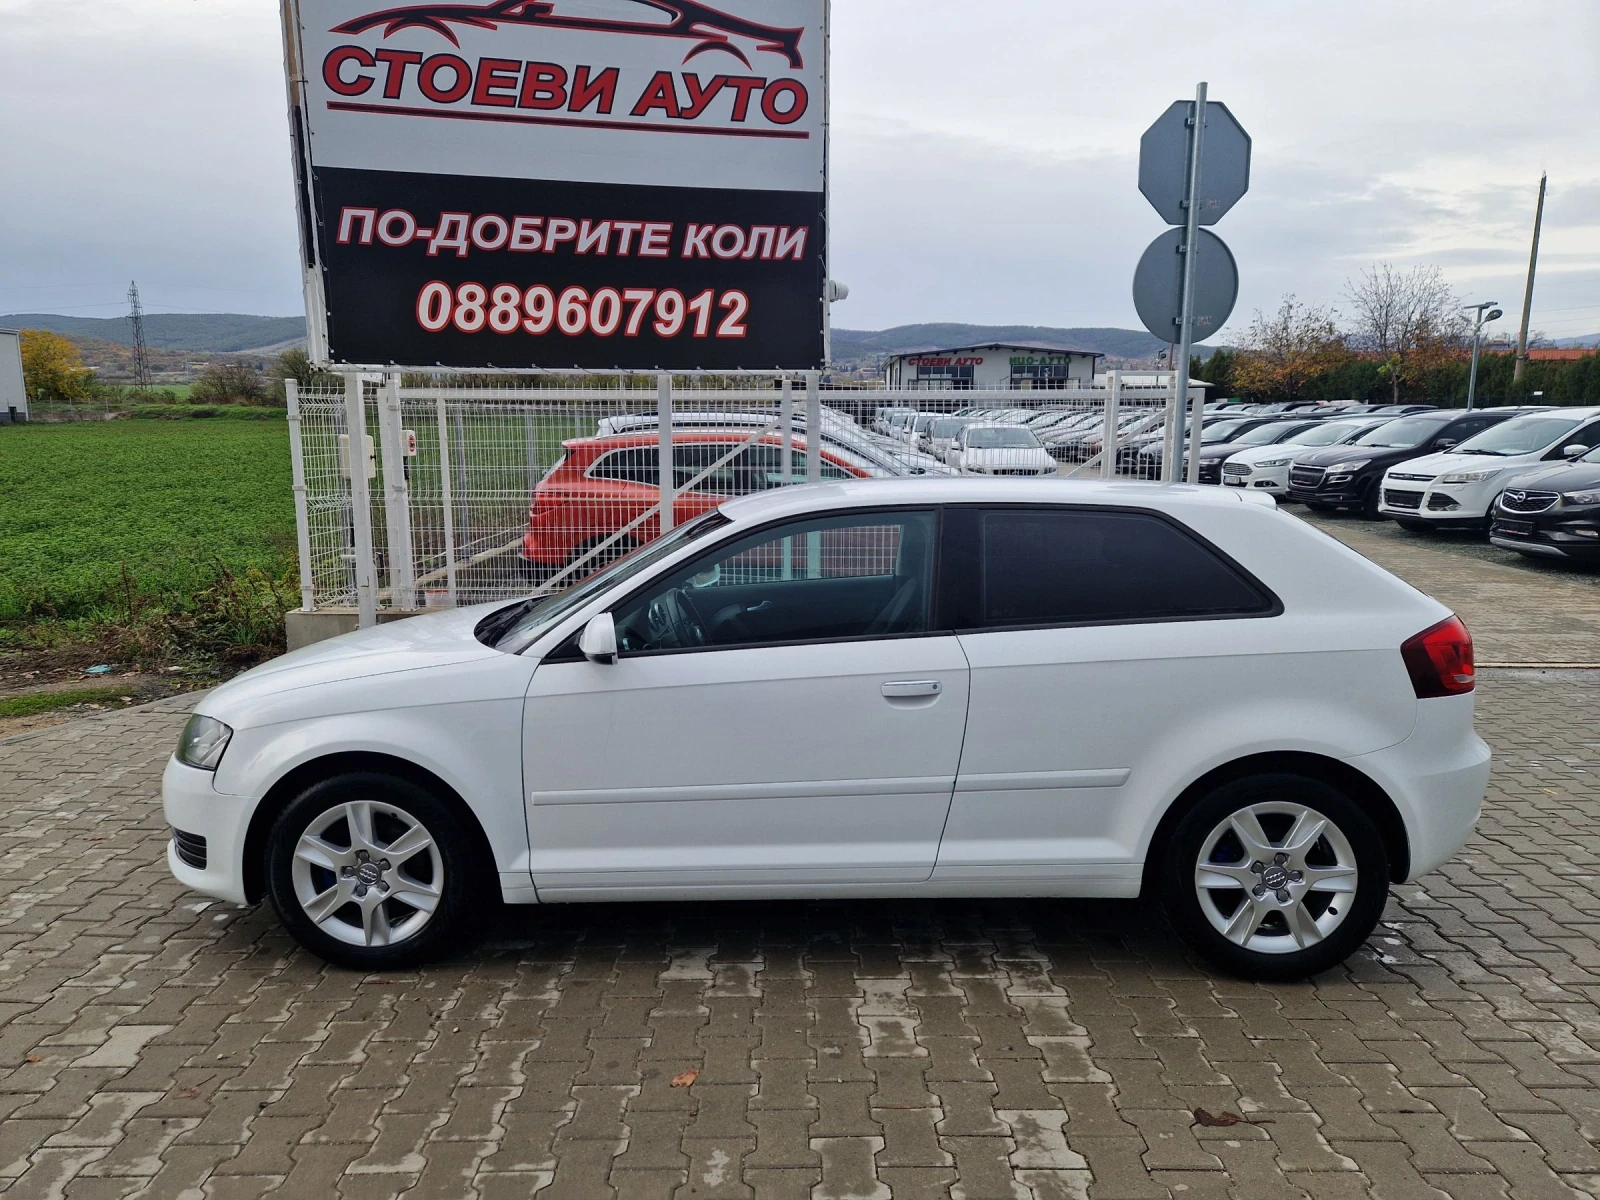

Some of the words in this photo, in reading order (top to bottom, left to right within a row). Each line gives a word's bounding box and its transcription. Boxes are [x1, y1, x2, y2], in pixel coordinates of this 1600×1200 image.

[322, 44, 620, 114] СТОЕВИ
[630, 70, 809, 124] АУТО
[336, 206, 673, 258] ПО-ДОБРИТЕ
[681, 223, 809, 261] КОЛИ
[416, 280, 749, 338] 0889607912
[908, 357, 951, 366] СТОЕВИ
[955, 357, 983, 366] АУТО
